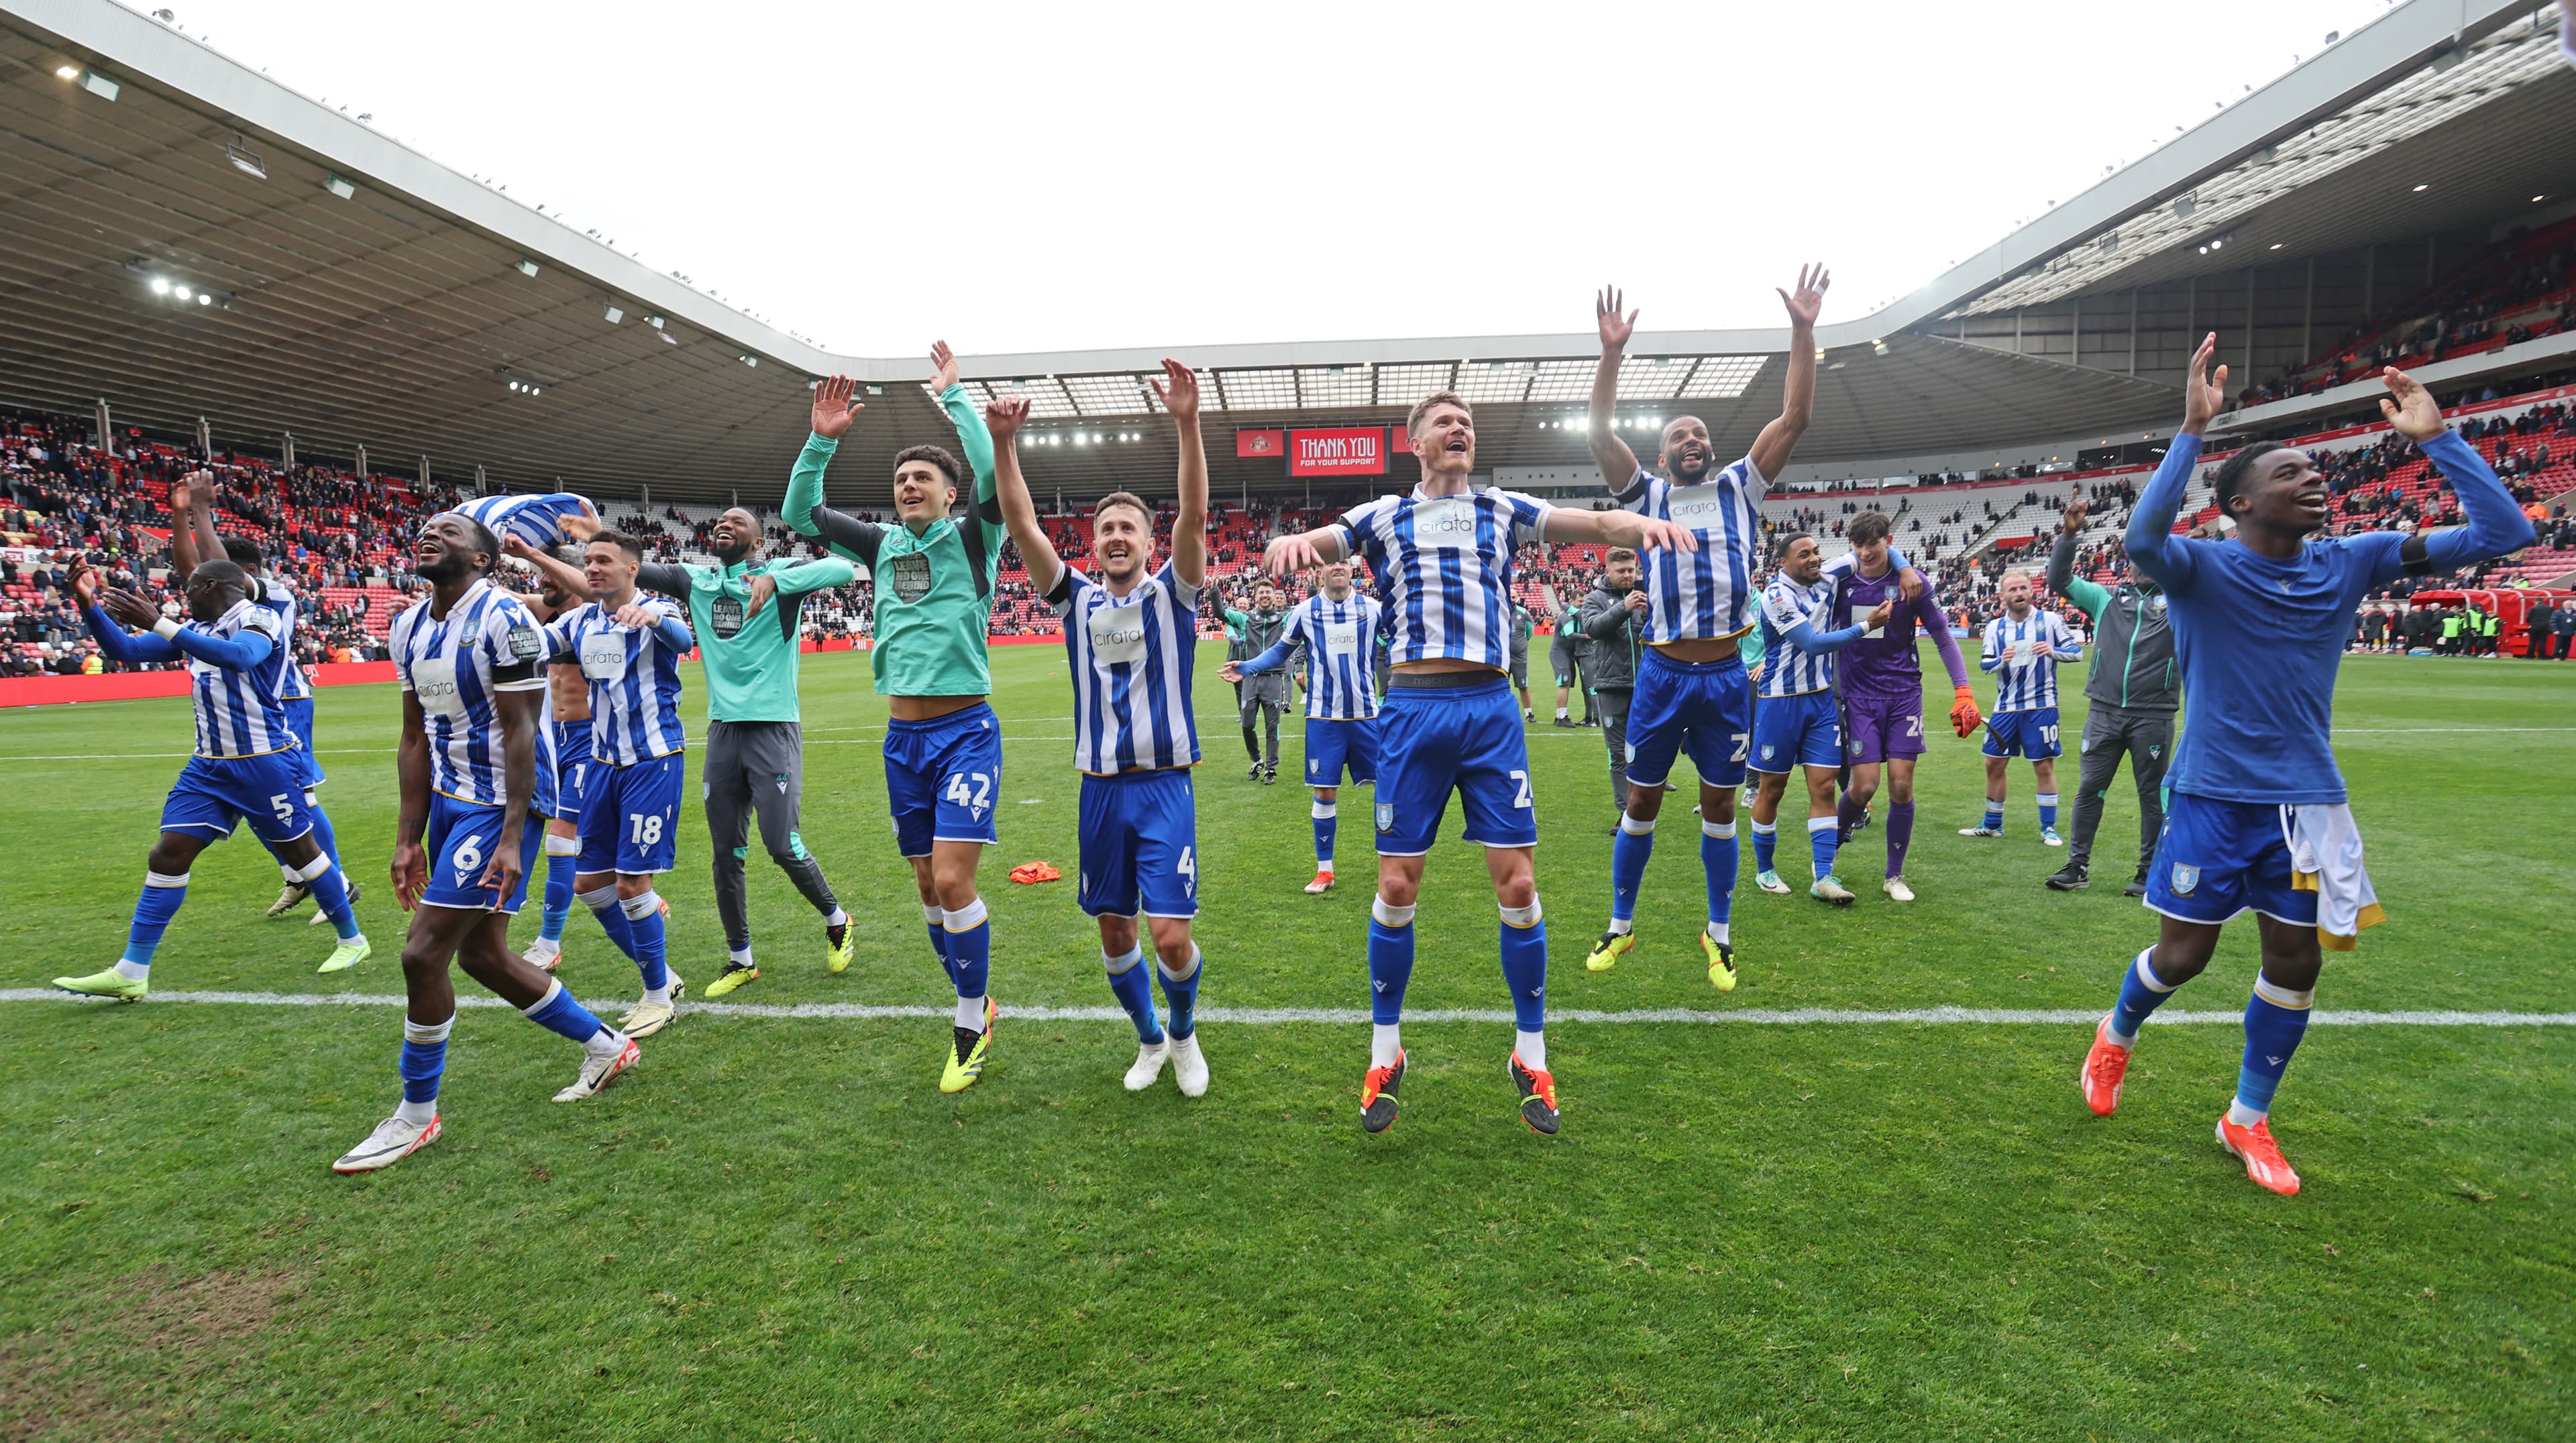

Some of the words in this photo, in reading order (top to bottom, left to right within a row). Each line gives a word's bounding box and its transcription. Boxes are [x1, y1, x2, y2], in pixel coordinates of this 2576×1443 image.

[1300, 438, 1346, 458] THANK
[1349, 437, 1375, 457] YOU
[1673, 502, 1716, 516] cirata
[1419, 517, 1472, 533] cirata
[894, 557, 928, 571] LEAVE
[896, 571, 910, 581] NO
[911, 571, 929, 581] ONE
[894, 580, 930, 590] BEHIND
[713, 604, 741, 614] LEAVE
[508, 631, 538, 642] LEAVE
[1094, 629, 1140, 646] cirata
[584, 652, 622, 665] cirata
[417, 680, 454, 698] cirata
[1413, 676, 1458, 686] macron
[2039, 725, 2058, 744] 10
[776, 773, 788, 782] 44
[947, 772, 990, 808] 42
[270, 792, 294, 820] 5
[630, 813, 663, 845] 18
[453, 835, 482, 871] 6
[1177, 845, 1195, 883] 4
